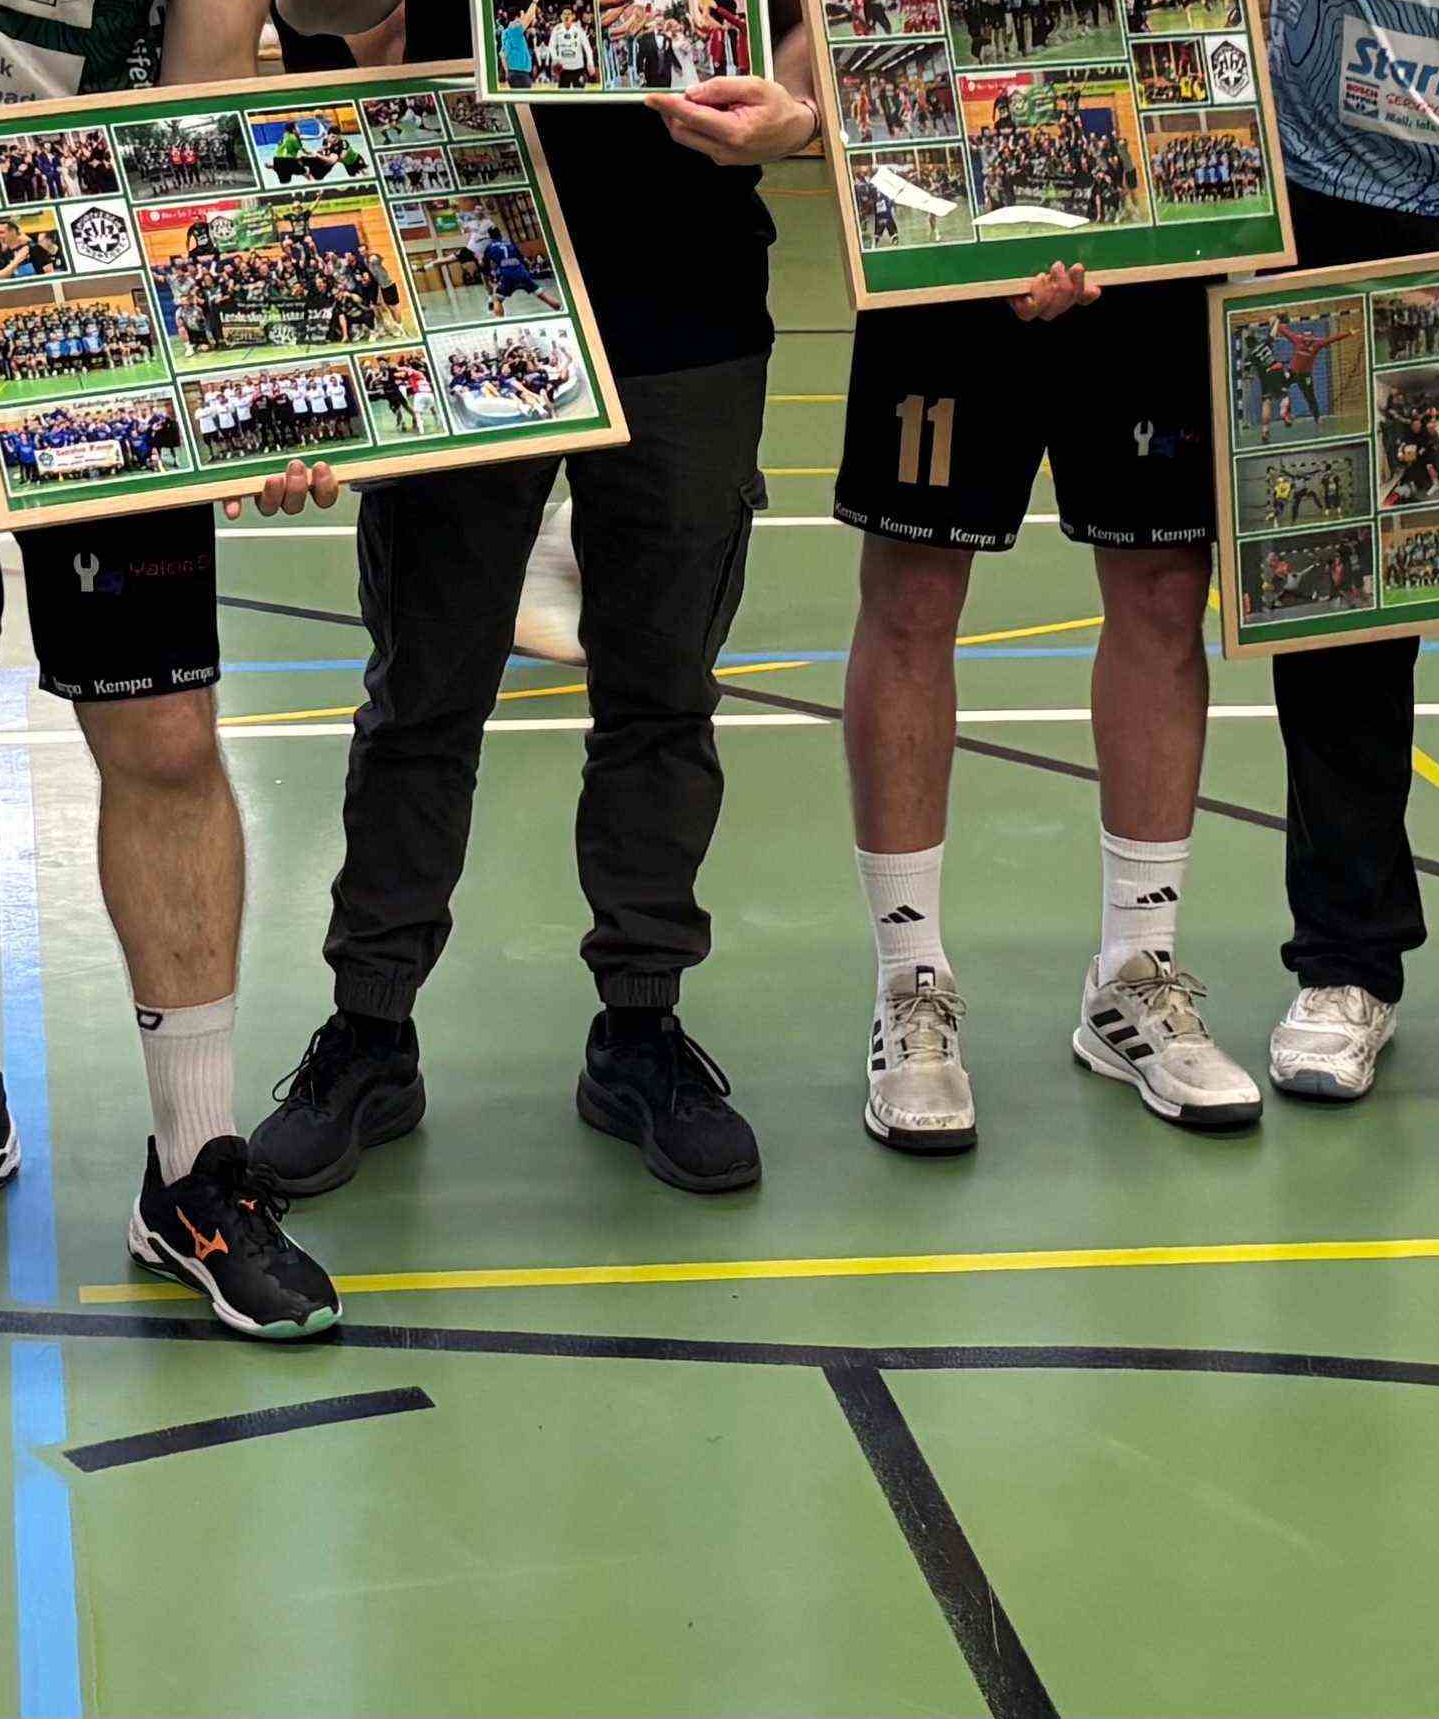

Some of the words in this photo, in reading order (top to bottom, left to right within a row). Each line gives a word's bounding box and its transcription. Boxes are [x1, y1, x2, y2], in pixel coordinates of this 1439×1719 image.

[896, 395, 955, 487] 11
[879, 514, 934, 540] Kempa
[1087, 524, 1135, 544] Kempa
[1151, 524, 1207, 544] Kempa
[94, 674, 154, 695] Kempa
